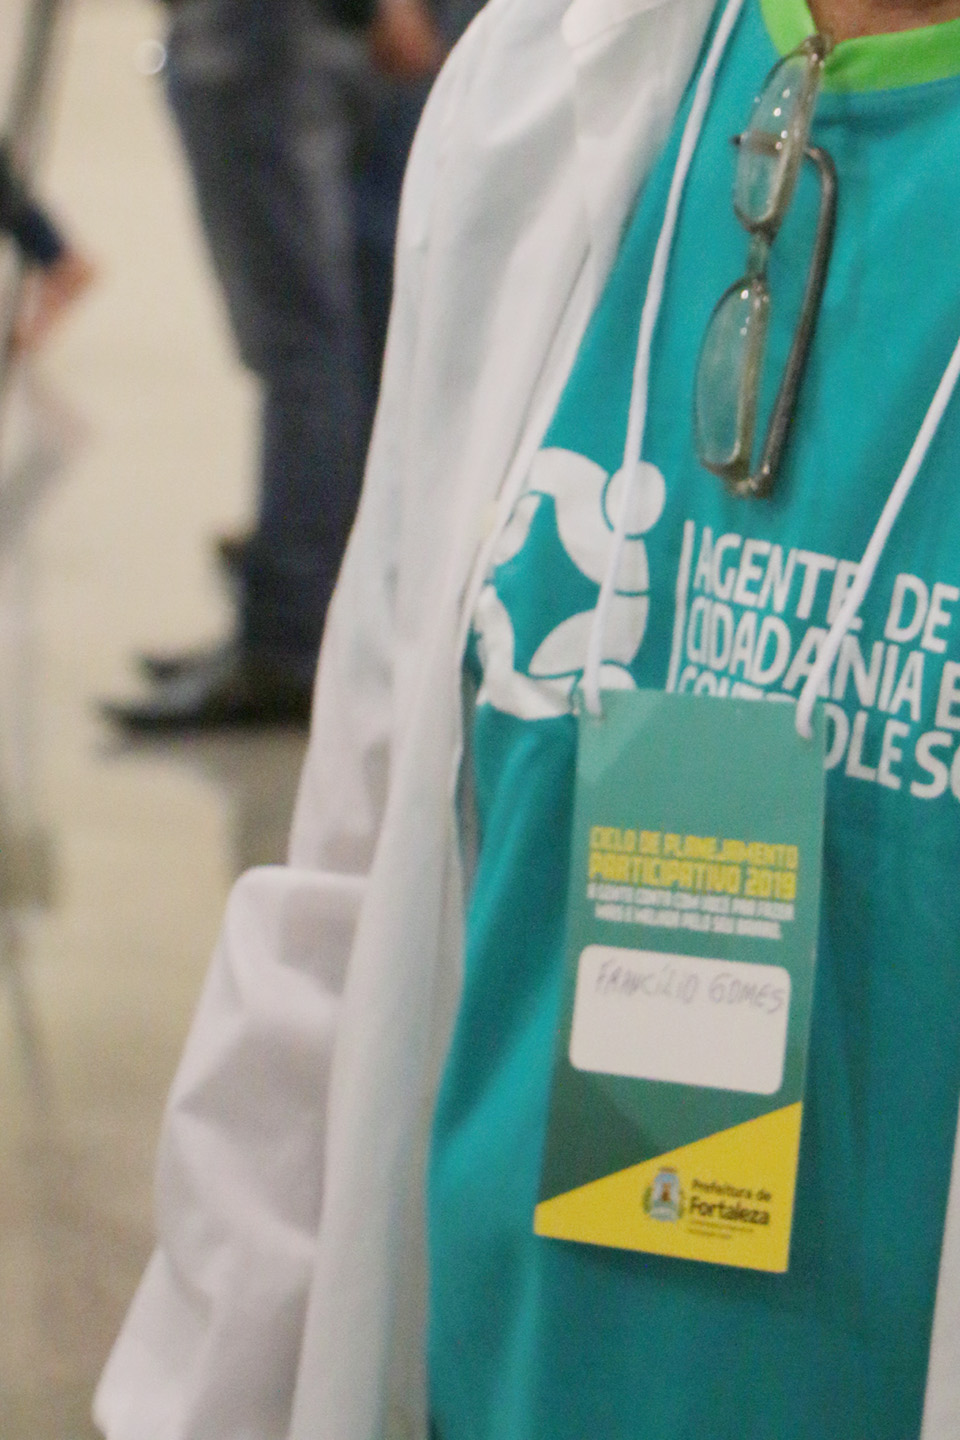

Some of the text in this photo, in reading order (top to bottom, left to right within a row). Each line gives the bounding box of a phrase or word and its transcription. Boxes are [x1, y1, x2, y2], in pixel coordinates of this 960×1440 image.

[693, 526, 960, 653] AGENTE DE
[687, 596, 925, 721] CIDADANIA
[588, 851, 741, 894] PARTICIPATIVO
[689, 1194, 770, 1226] Fortaleza
[691, 1178, 752, 1199] Prefeitura
